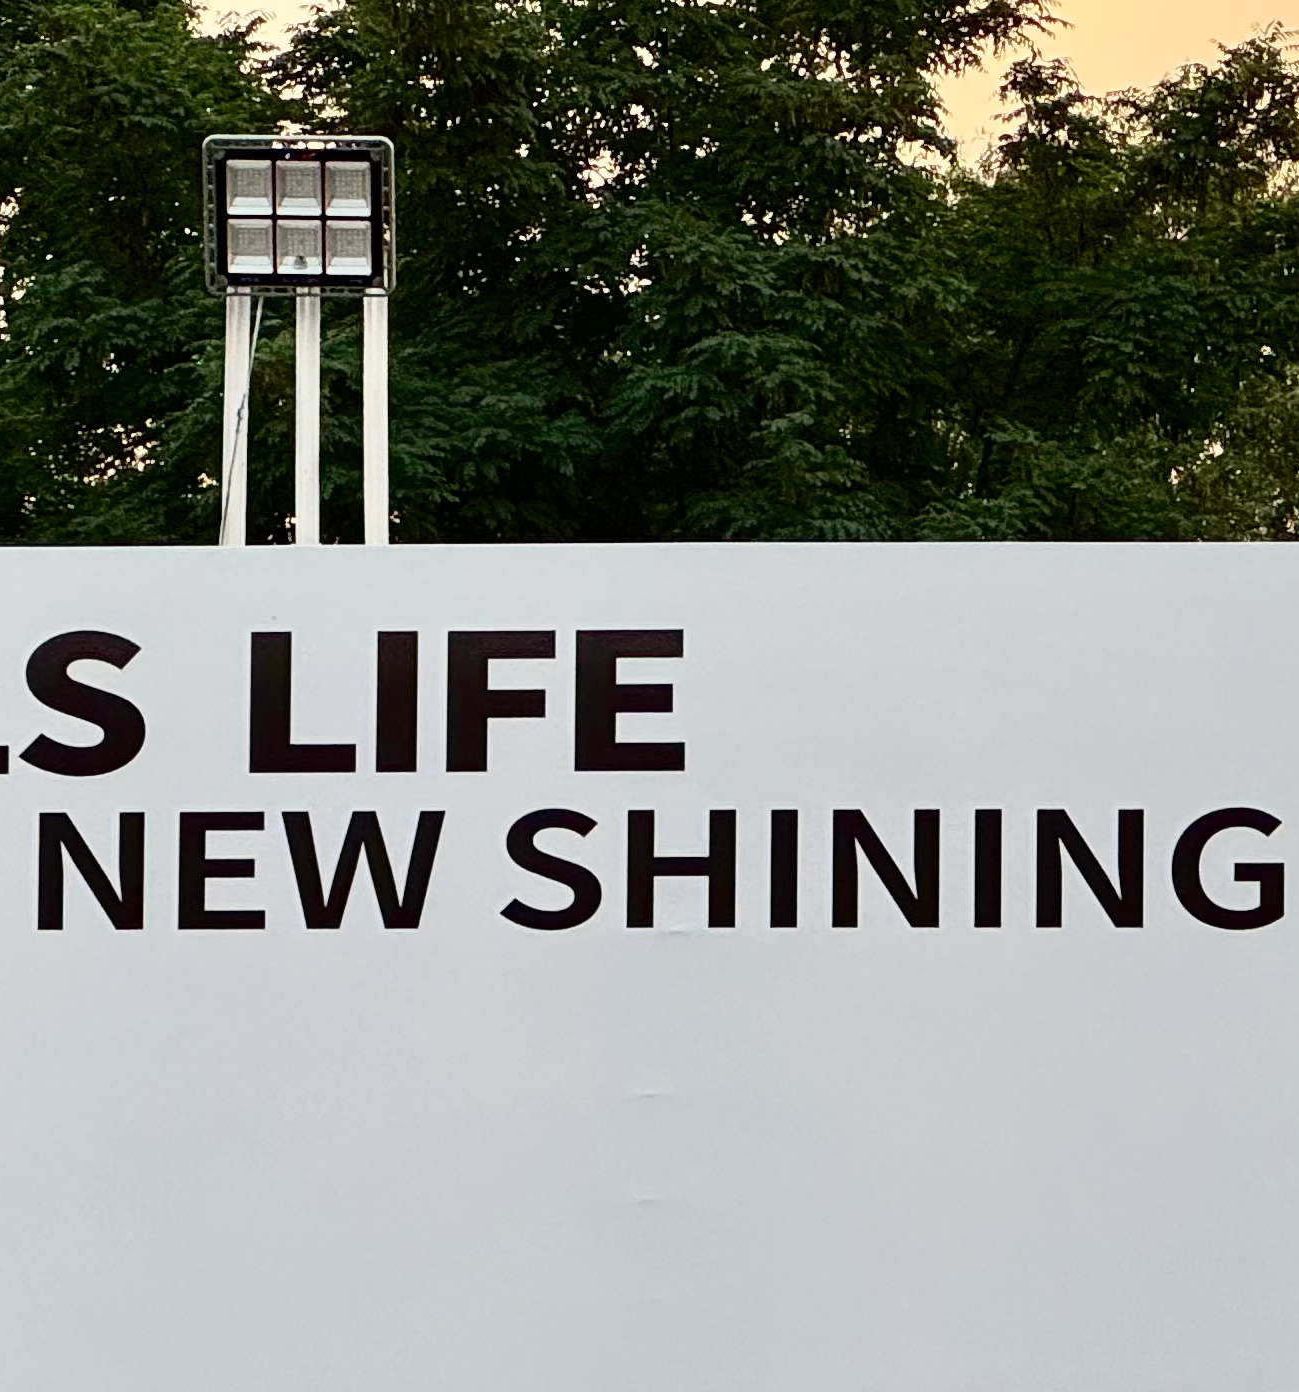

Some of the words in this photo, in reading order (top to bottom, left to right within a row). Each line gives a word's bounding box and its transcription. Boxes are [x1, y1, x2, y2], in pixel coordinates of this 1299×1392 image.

[249, 629, 685, 773] LIFE
[38, 811, 445, 930] NEW
[500, 808, 1284, 930] SHINING
